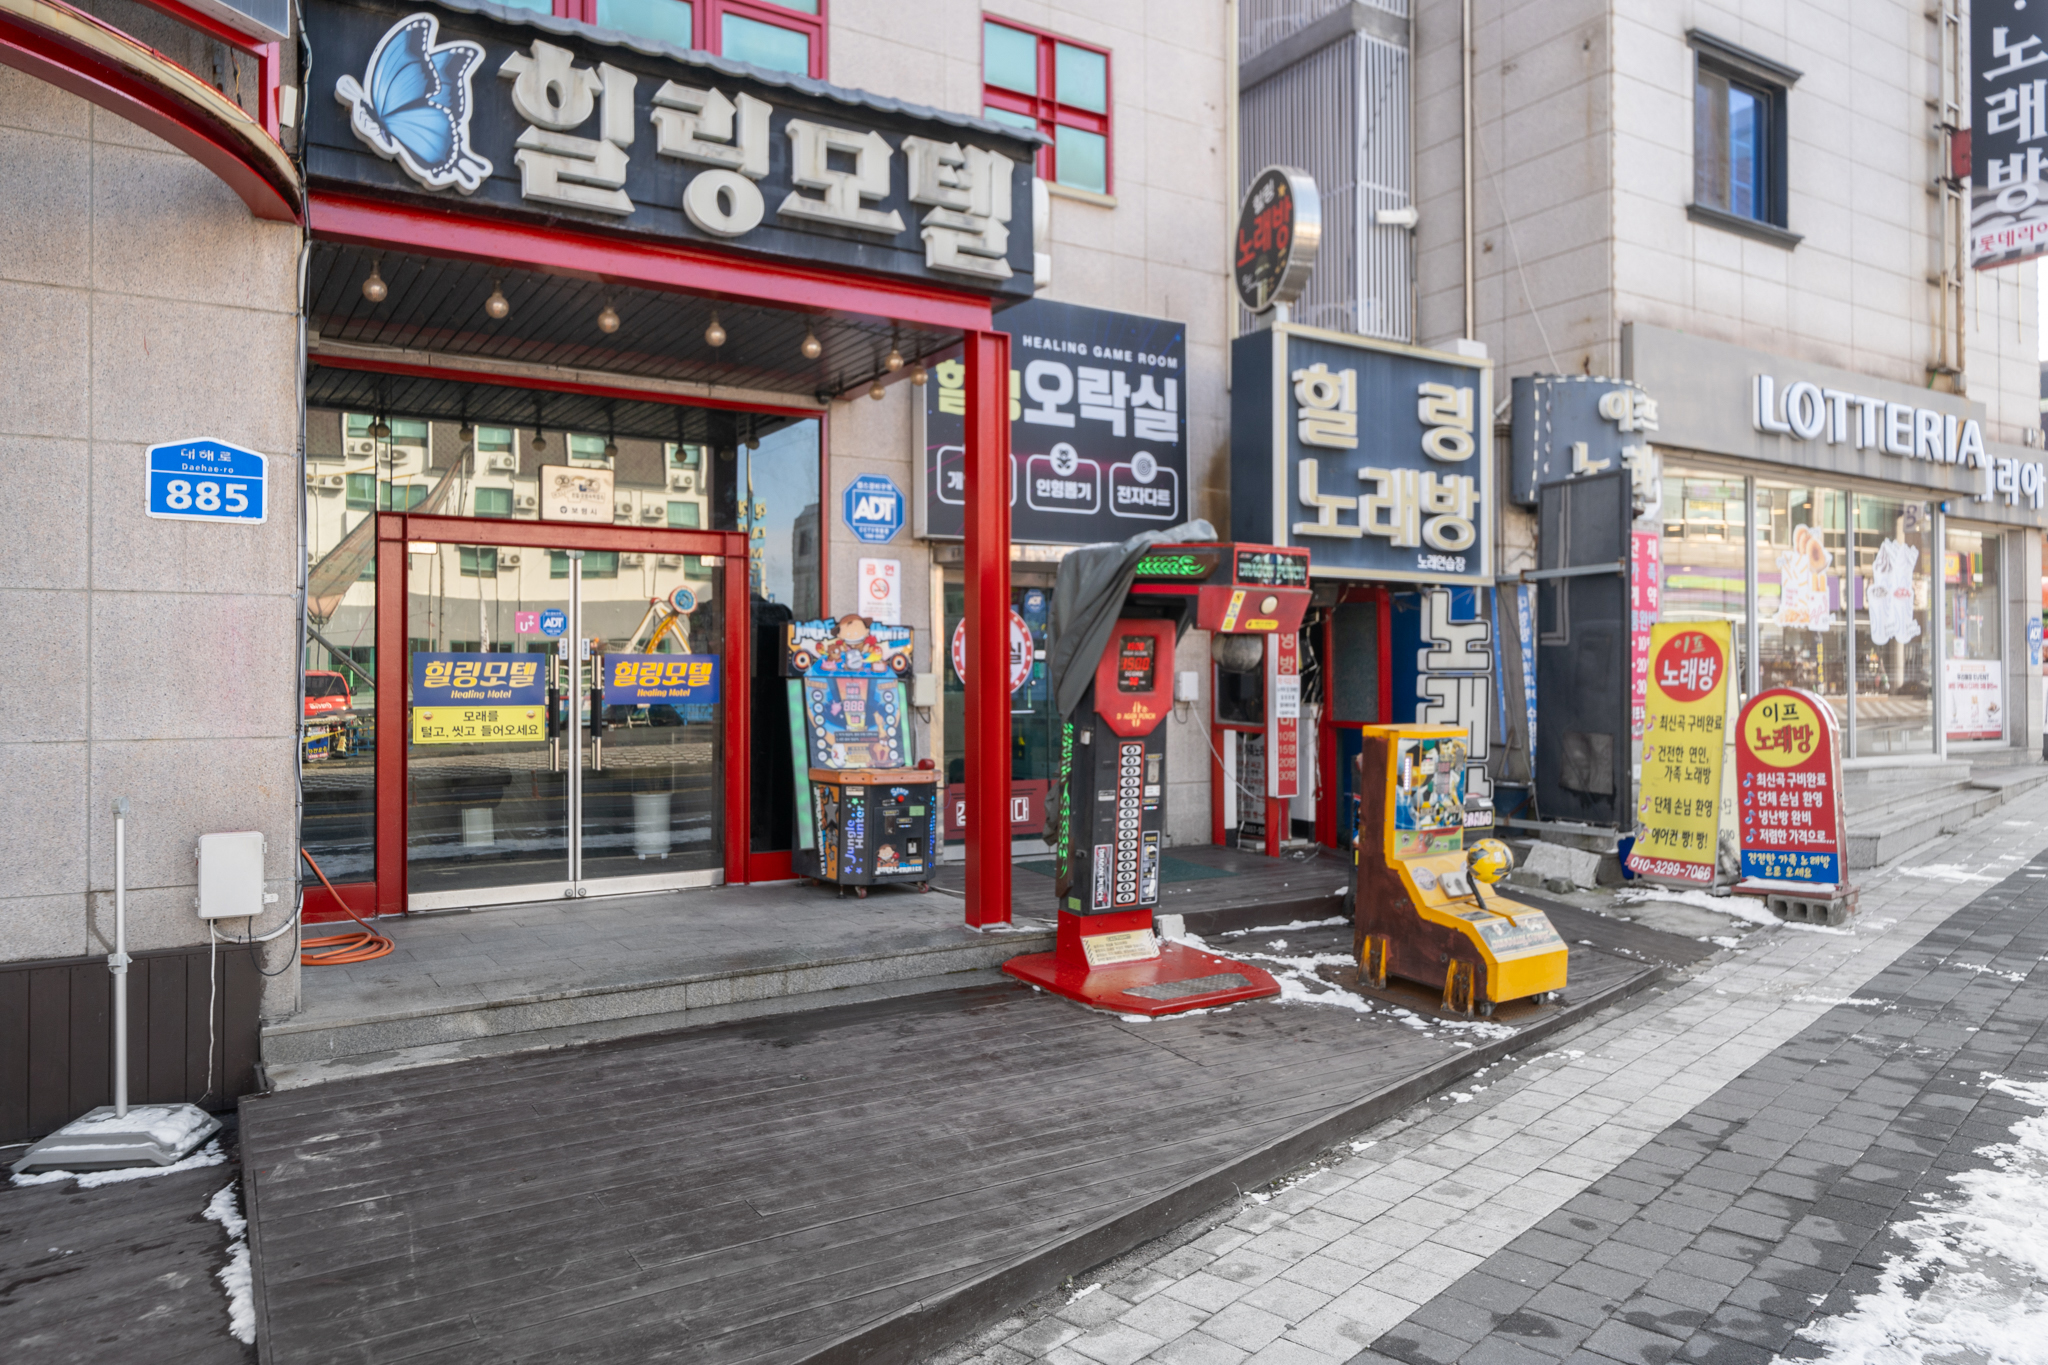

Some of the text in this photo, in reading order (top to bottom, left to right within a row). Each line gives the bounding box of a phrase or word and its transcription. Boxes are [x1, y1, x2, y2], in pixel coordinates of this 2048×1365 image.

[499, 38, 1013, 281] 힐링모텔
[1236, 195, 1292, 268] 노래방
[1022, 335, 1178, 369] HEALING GAME ROOM
[1753, 374, 1987, 470] LOTTERIA
[180, 448, 231, 462] 대해로
[181, 462, 234, 474] Daehae-ro
[166, 479, 249, 513] 885
[1116, 485, 1171, 507] 전자다트
[1292, 458, 1480, 552] 노래방
[853, 496, 896, 522] ADT
[866, 564, 895, 577] 금연
[1416, 553, 1467, 573] 노래연습장
[543, 617, 565, 629] ADT
[424, 660, 538, 688] 힐링모텔
[613, 661, 713, 687] 힐링모텔
[1659, 655, 1717, 692] 노래방
[451, 689, 512, 699] Healing Motel
[637, 688, 691, 698] Healing Motel
[463, 710, 499, 722] 모래를
[1763, 702, 1799, 723] 이프
[421, 724, 539, 738] 털고, 씻고 들어오세요
[1659, 714, 1686, 733] 최신곡
[1687, 714, 1723, 733] 구비완료
[1753, 723, 1814, 754] 노래방
[1658, 745, 1709, 764] 건전한 연인,
[1664, 765, 1711, 785] 가족 노래방
[1756, 772, 1827, 789] 최신곡 구비완료
[1654, 796, 1713, 818] 단체 손님 환영
[1757, 790, 1823, 808] 단체 손님 환영
[1758, 809, 1812, 827] 냉난방 완비
[845, 805, 865, 865] Jungle Hunter
[1651, 827, 1679, 847] 에어컨
[1759, 828, 1787, 845] 저렴한
[1630, 856, 1712, 881] 010-3299-7066
[1765, 865, 1813, 879] 으로 오세요
[1800, 854, 1831, 870] 노래방
